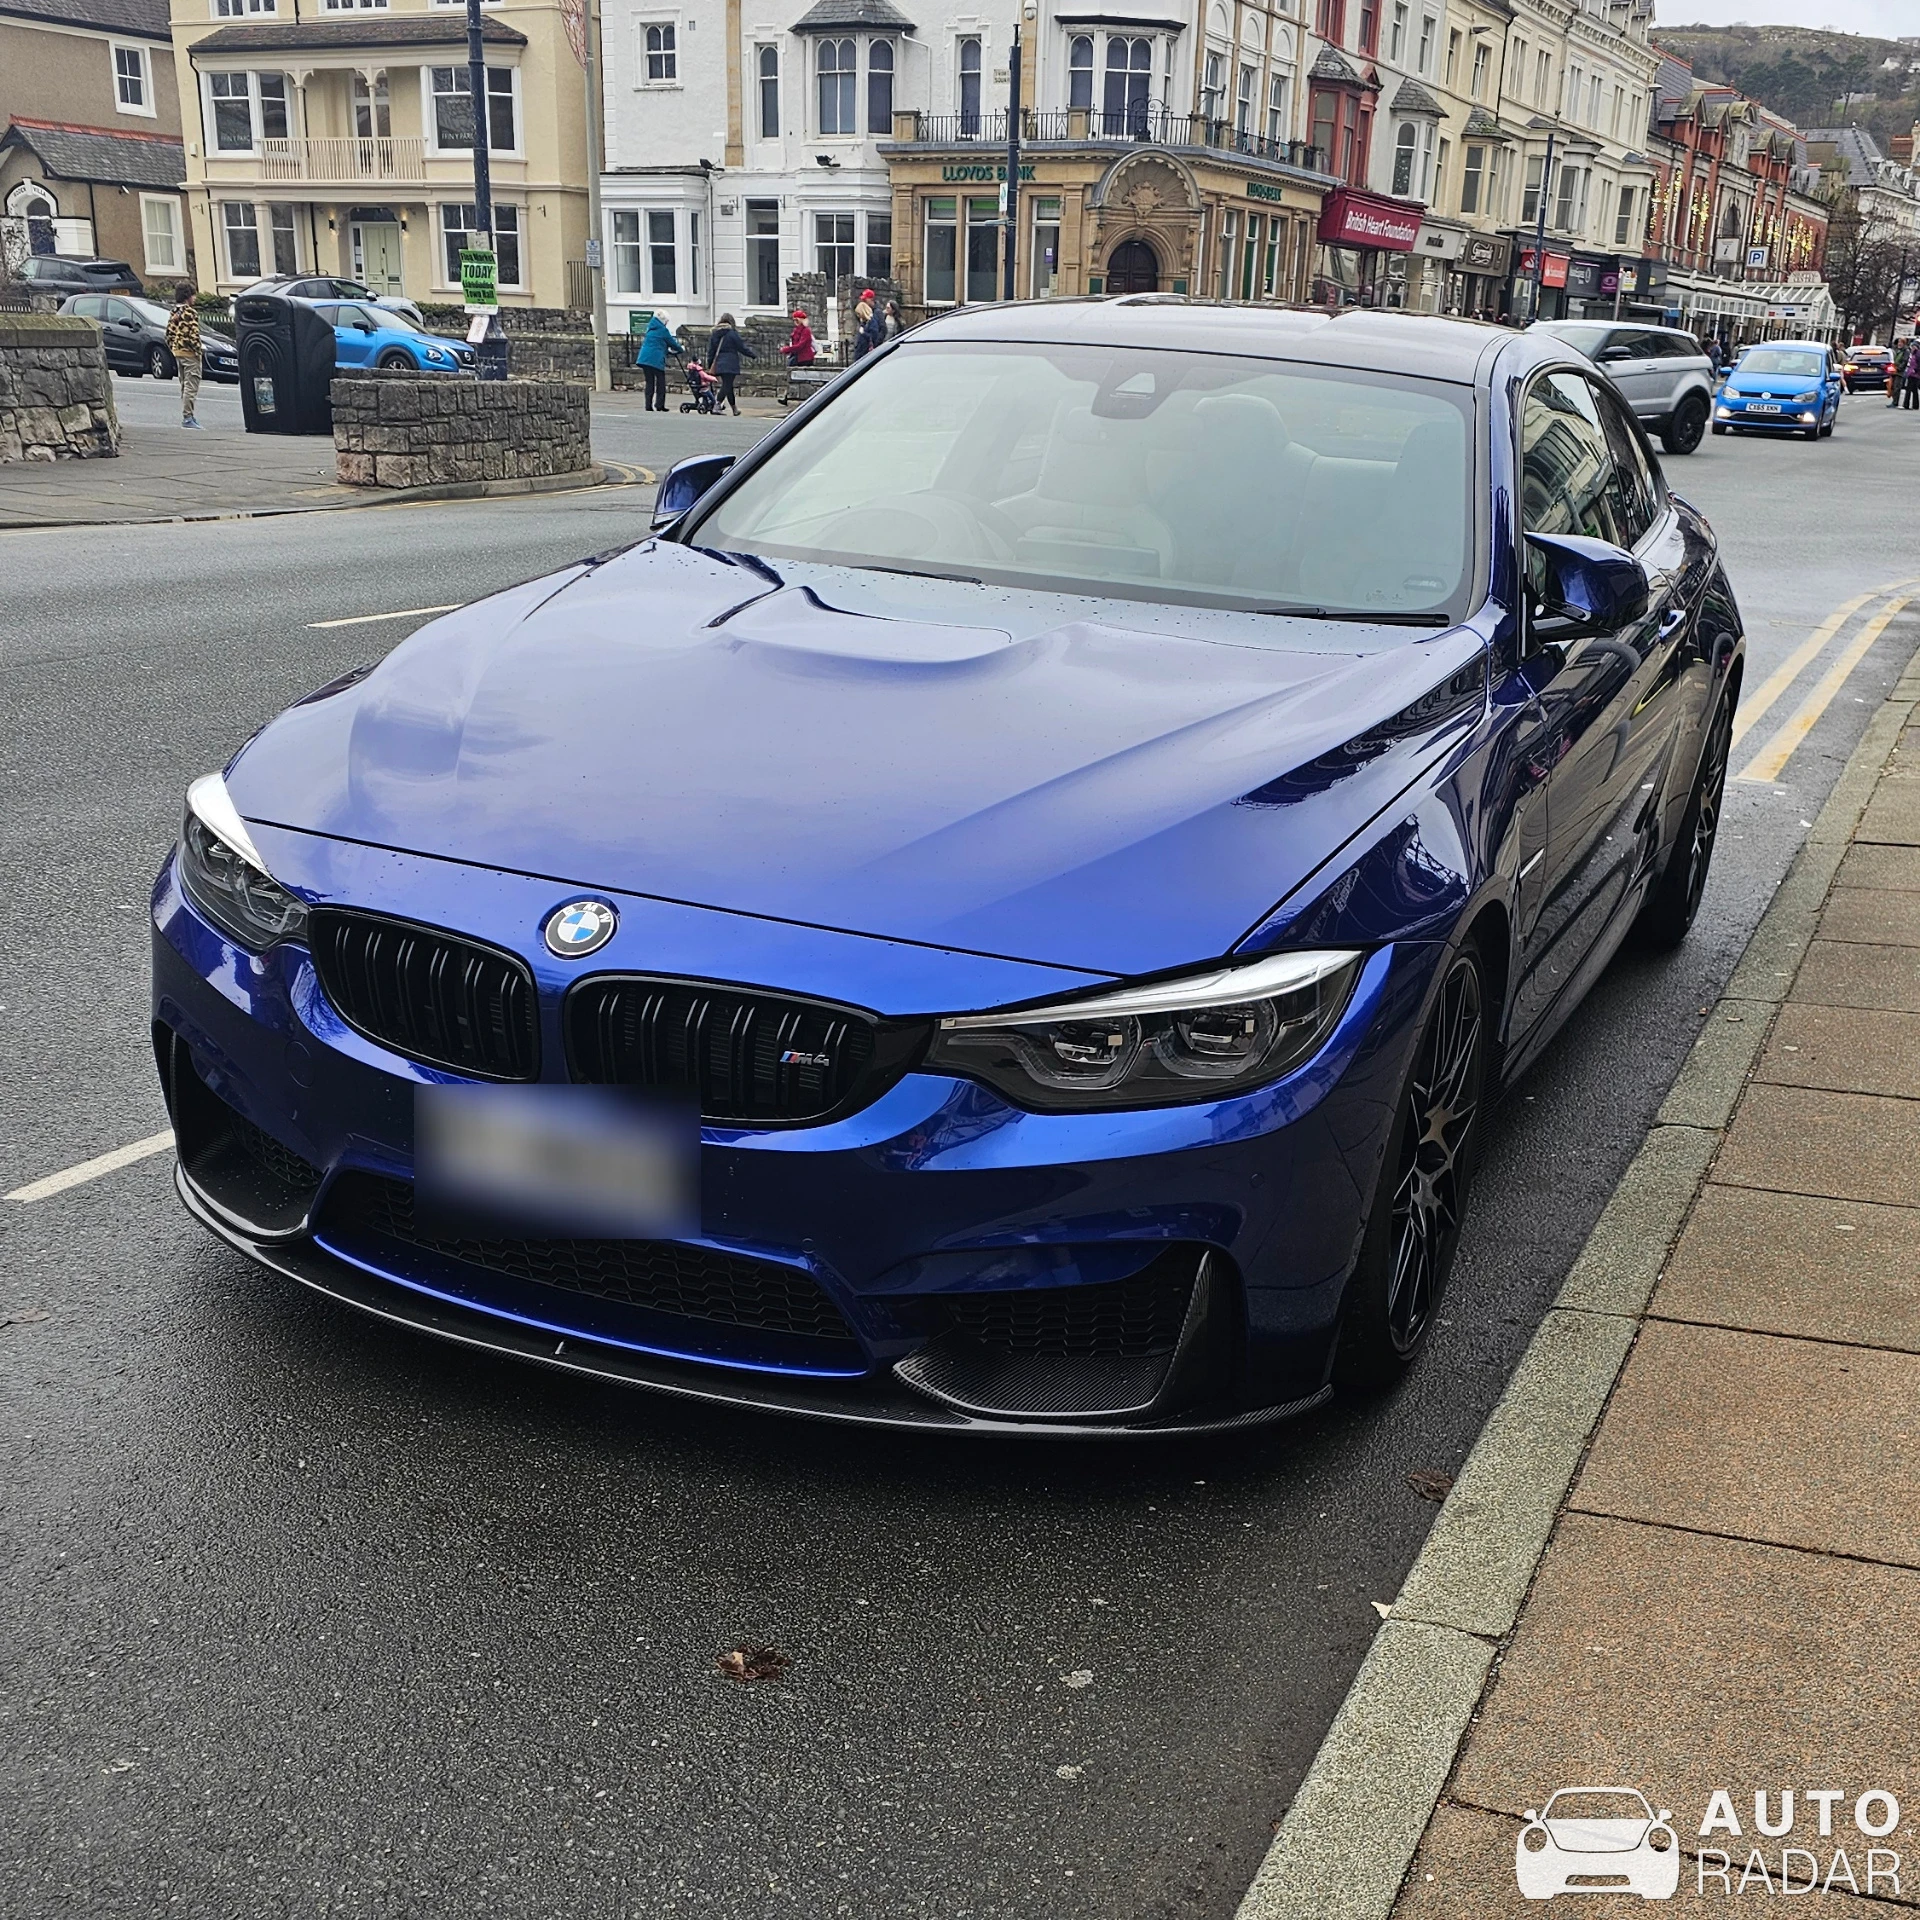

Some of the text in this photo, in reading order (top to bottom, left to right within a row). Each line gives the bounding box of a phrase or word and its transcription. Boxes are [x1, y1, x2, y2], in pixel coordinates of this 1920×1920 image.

[942, 166, 1036, 180] LLOYDS BNK
[1345, 211, 1367, 232] British
[1365, 216, 1384, 236] Heart
[1382, 219, 1415, 241] Foundation
[464, 264, 493, 279] TODAY
[465, 289, 481, 298] Town
[563, 903, 611, 923] BMW
